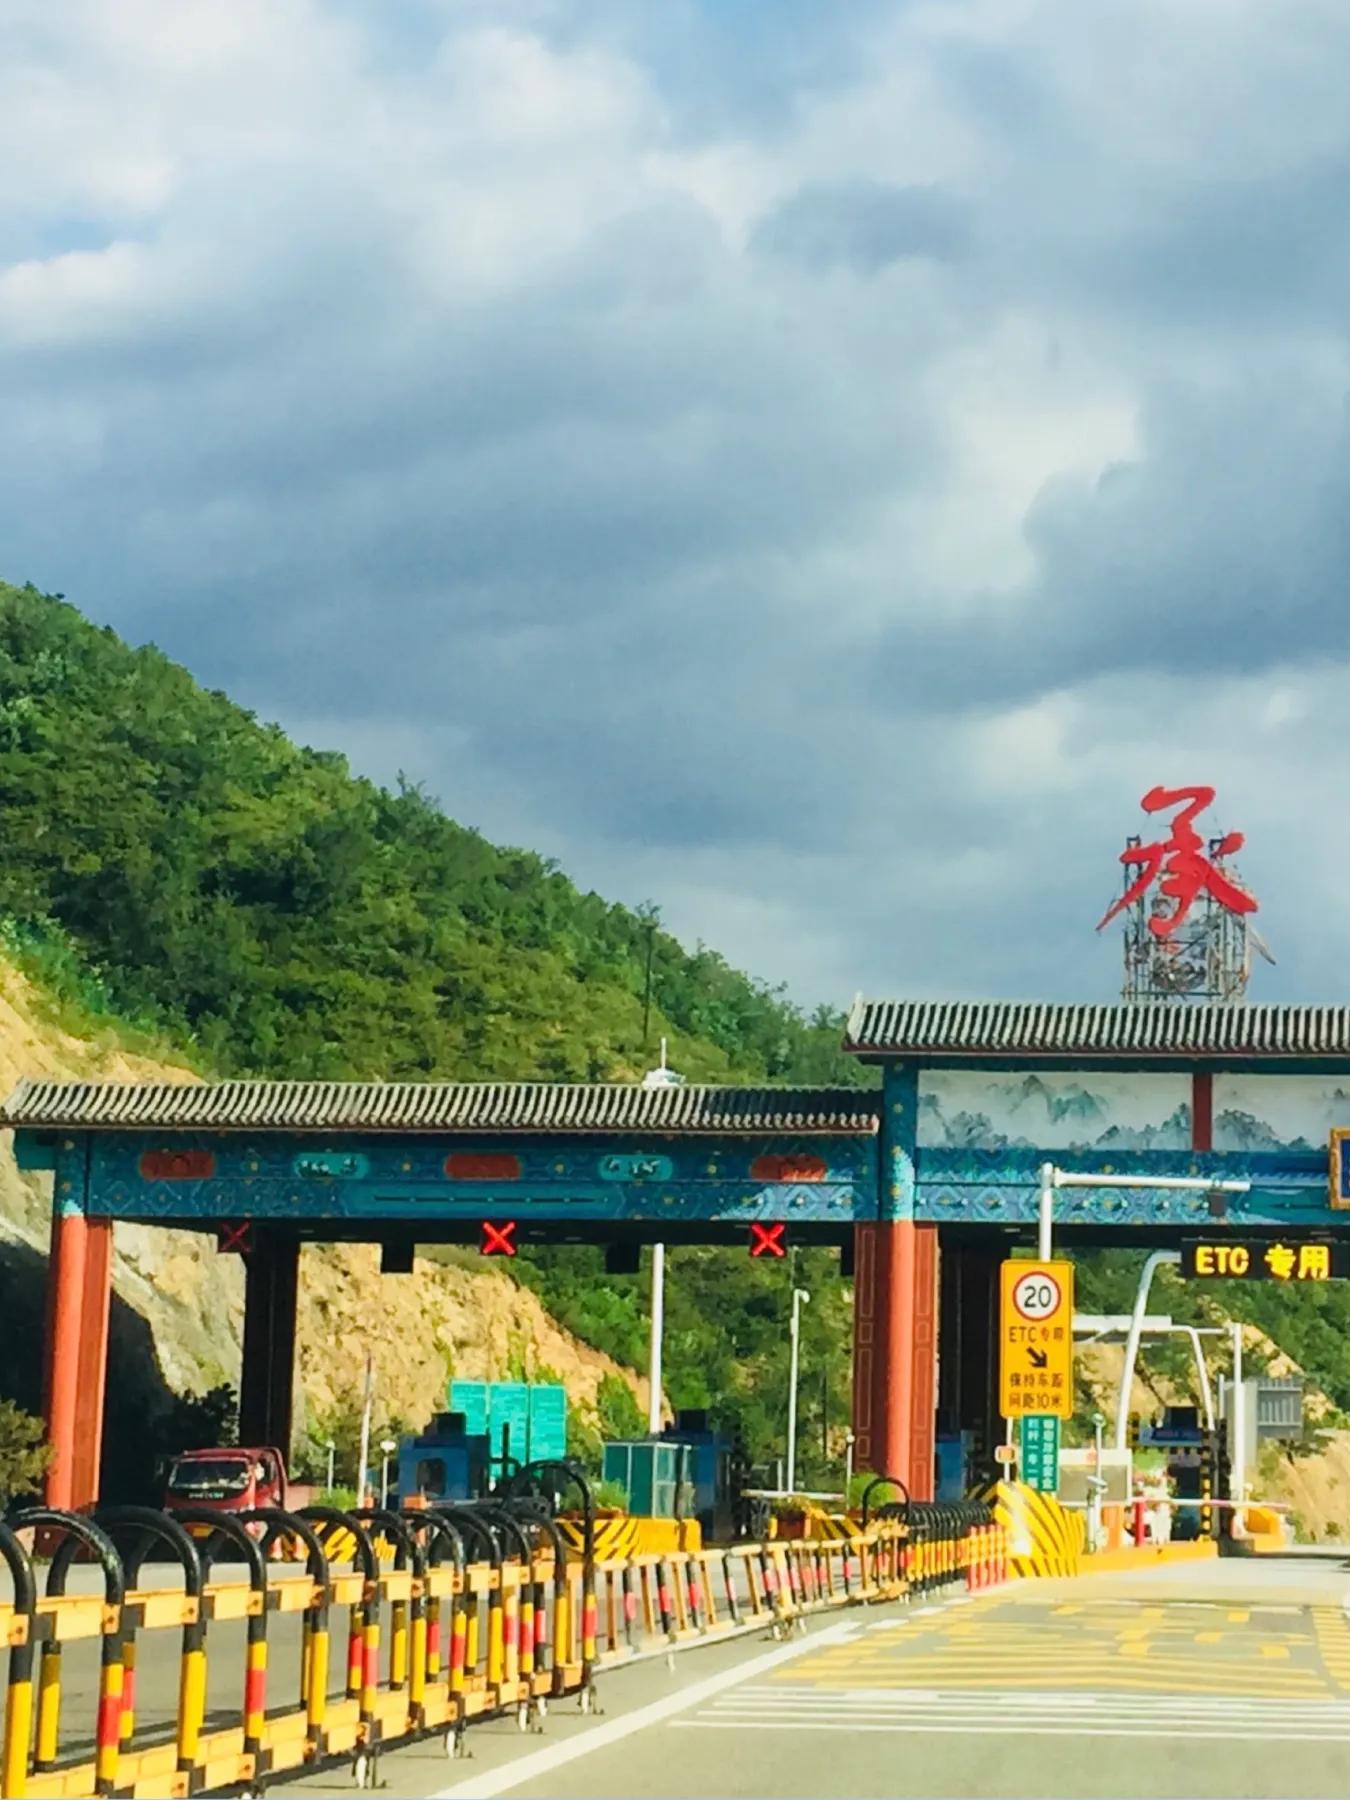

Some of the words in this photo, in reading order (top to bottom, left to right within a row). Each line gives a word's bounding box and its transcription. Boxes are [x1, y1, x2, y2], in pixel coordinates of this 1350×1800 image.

[1196, 1245, 1249, 1275] ETC
[1264, 1243, 1330, 1280] 专用
[1023, 1285, 1051, 1308] 20
